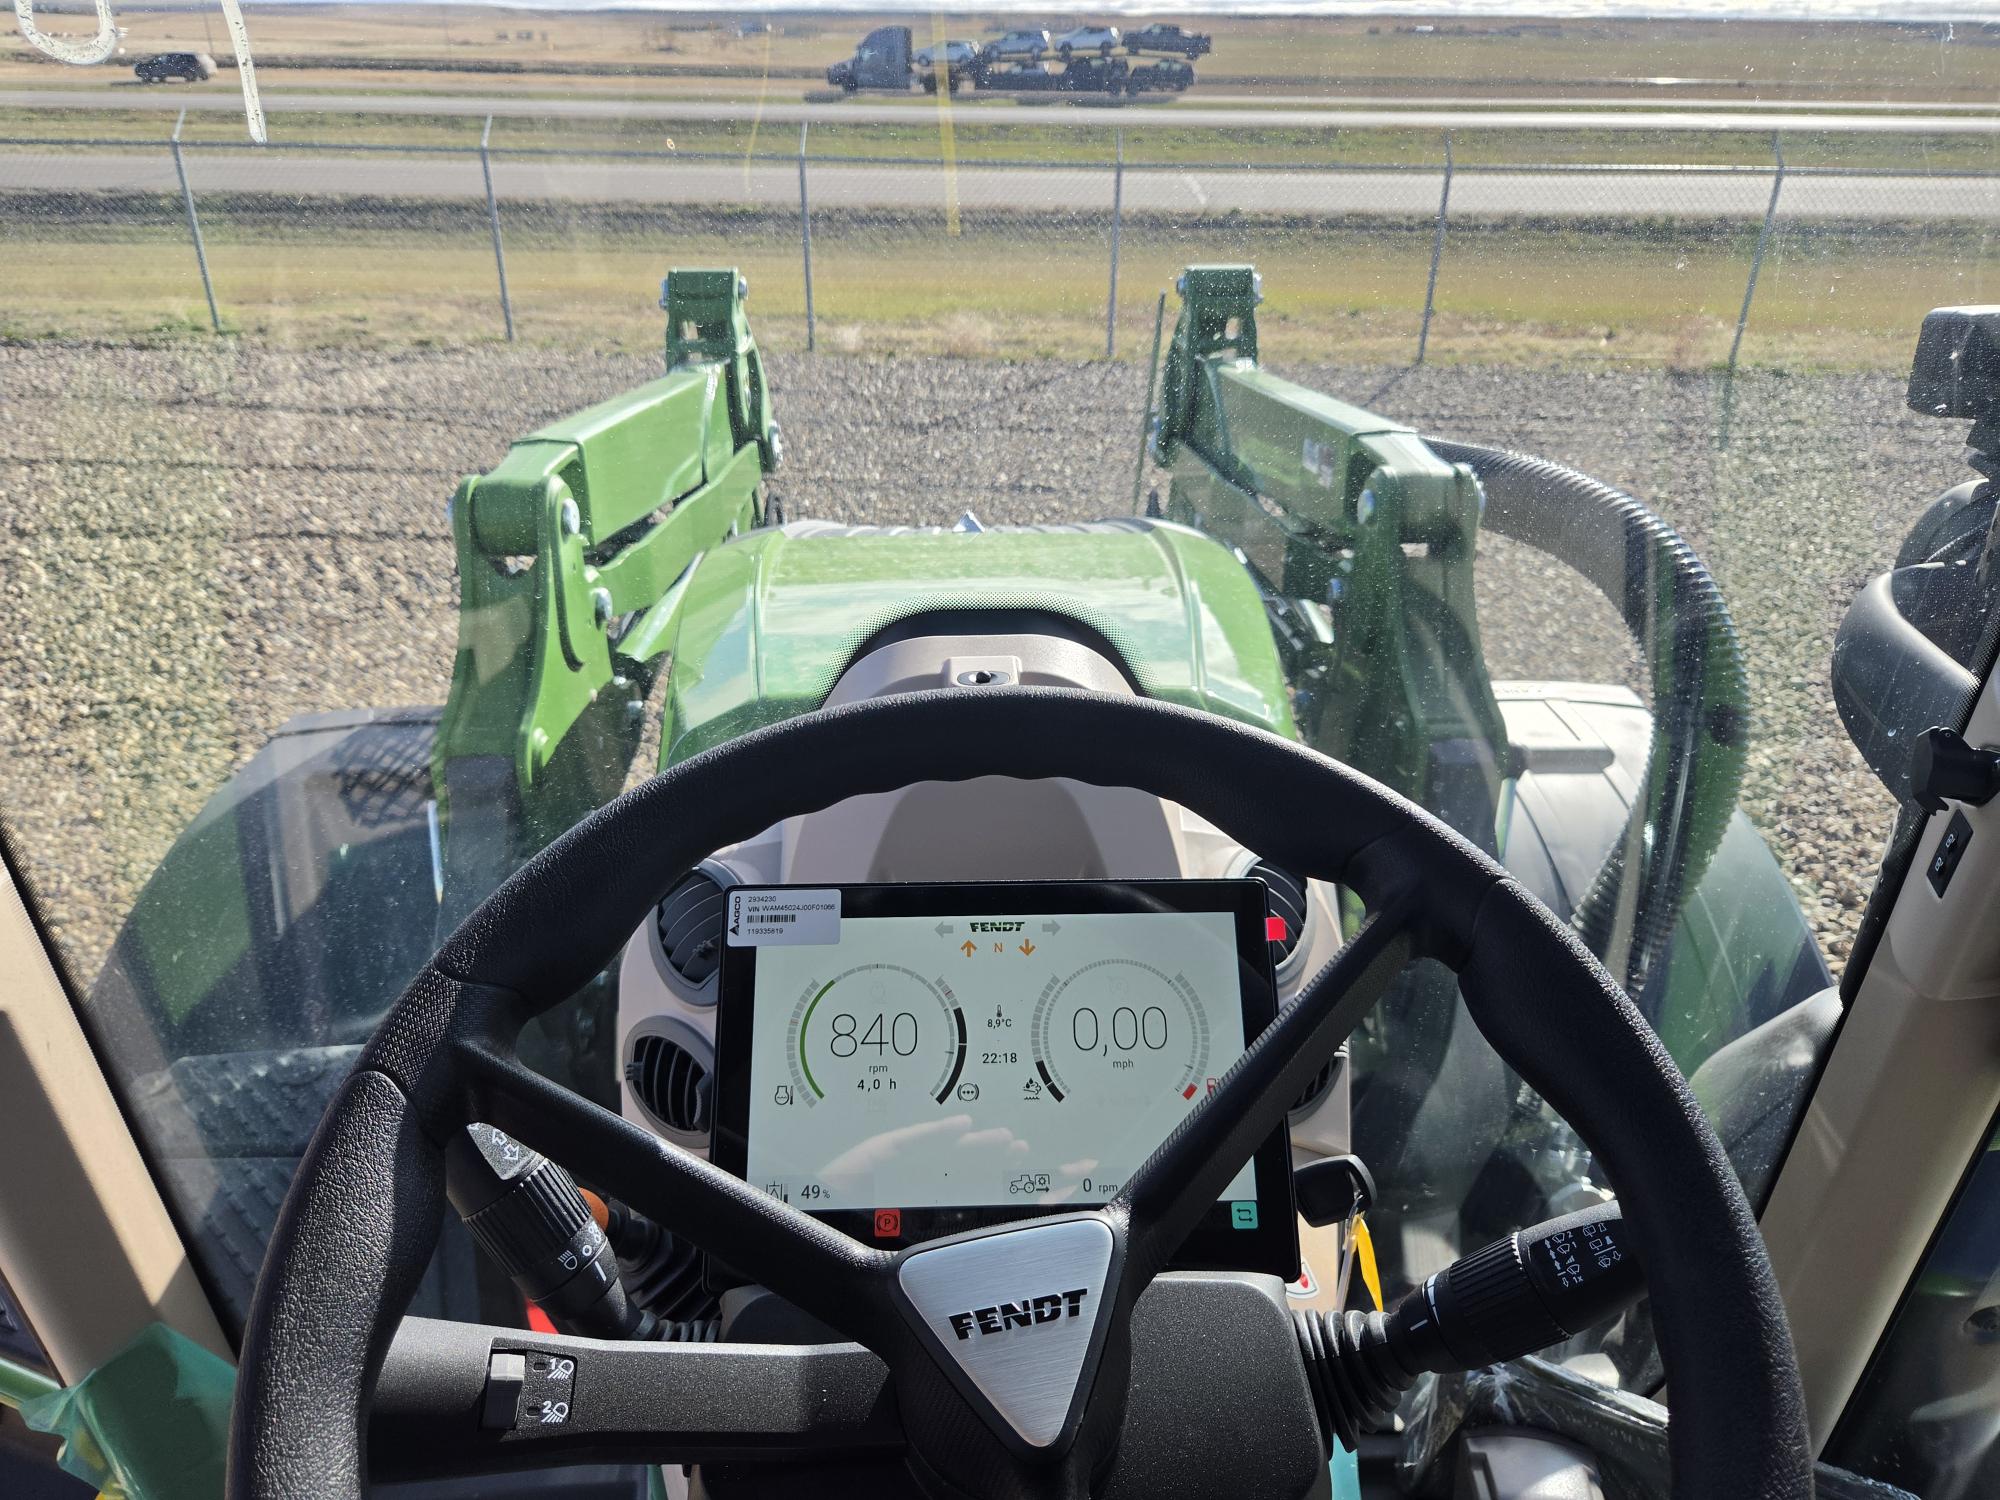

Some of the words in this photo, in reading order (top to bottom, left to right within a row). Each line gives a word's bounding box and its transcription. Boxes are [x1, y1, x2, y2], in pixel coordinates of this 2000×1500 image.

[733, 896, 741, 928] AGCO
[969, 921, 1026, 933] FENDT
[993, 942, 1003, 953] N
[830, 1012, 918, 1057] 840
[1073, 1006, 1168, 1056] 0,00
[982, 1052, 1017, 1064] 22:18
[1112, 1059, 1134, 1070] mph
[868, 1064, 888, 1074] rpm
[857, 1079, 881, 1093] 4,0
[889, 1078, 897, 1090] h
[1083, 1178, 1092, 1193] 0
[1098, 1183, 1118, 1194] rpm
[948, 1288, 1088, 1341] FENDT
[549, 1358, 557, 1370] 1
[542, 1400, 552, 1413] 2
